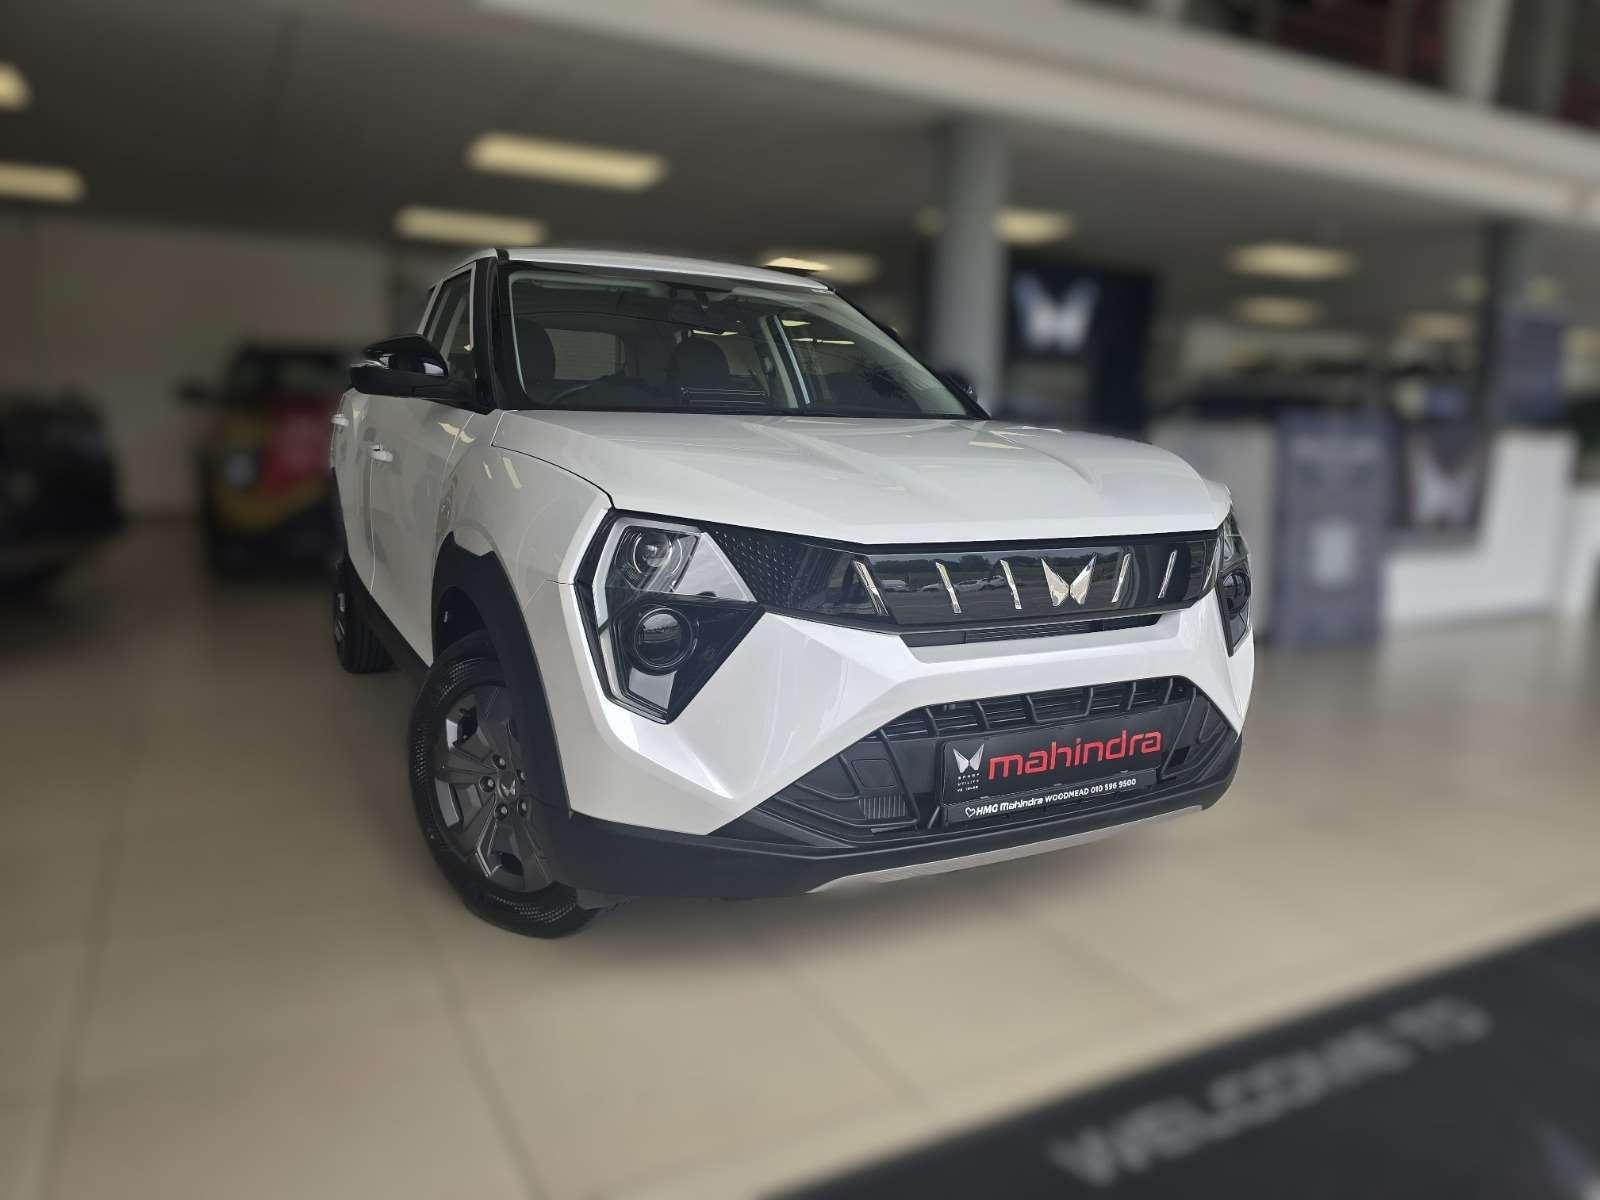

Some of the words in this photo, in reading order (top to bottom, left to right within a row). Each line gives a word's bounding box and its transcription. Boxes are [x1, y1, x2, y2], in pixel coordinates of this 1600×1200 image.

[988, 729, 1162, 780] mahindra
[975, 804, 998, 816] HMG
[999, 796, 1044, 812] Mahindra
[1045, 788, 1090, 802] WOODMEAD
[1090, 785, 1104, 794] 010
[1104, 782, 1118, 792] 596
[1118, 778, 1137, 788] 9500
